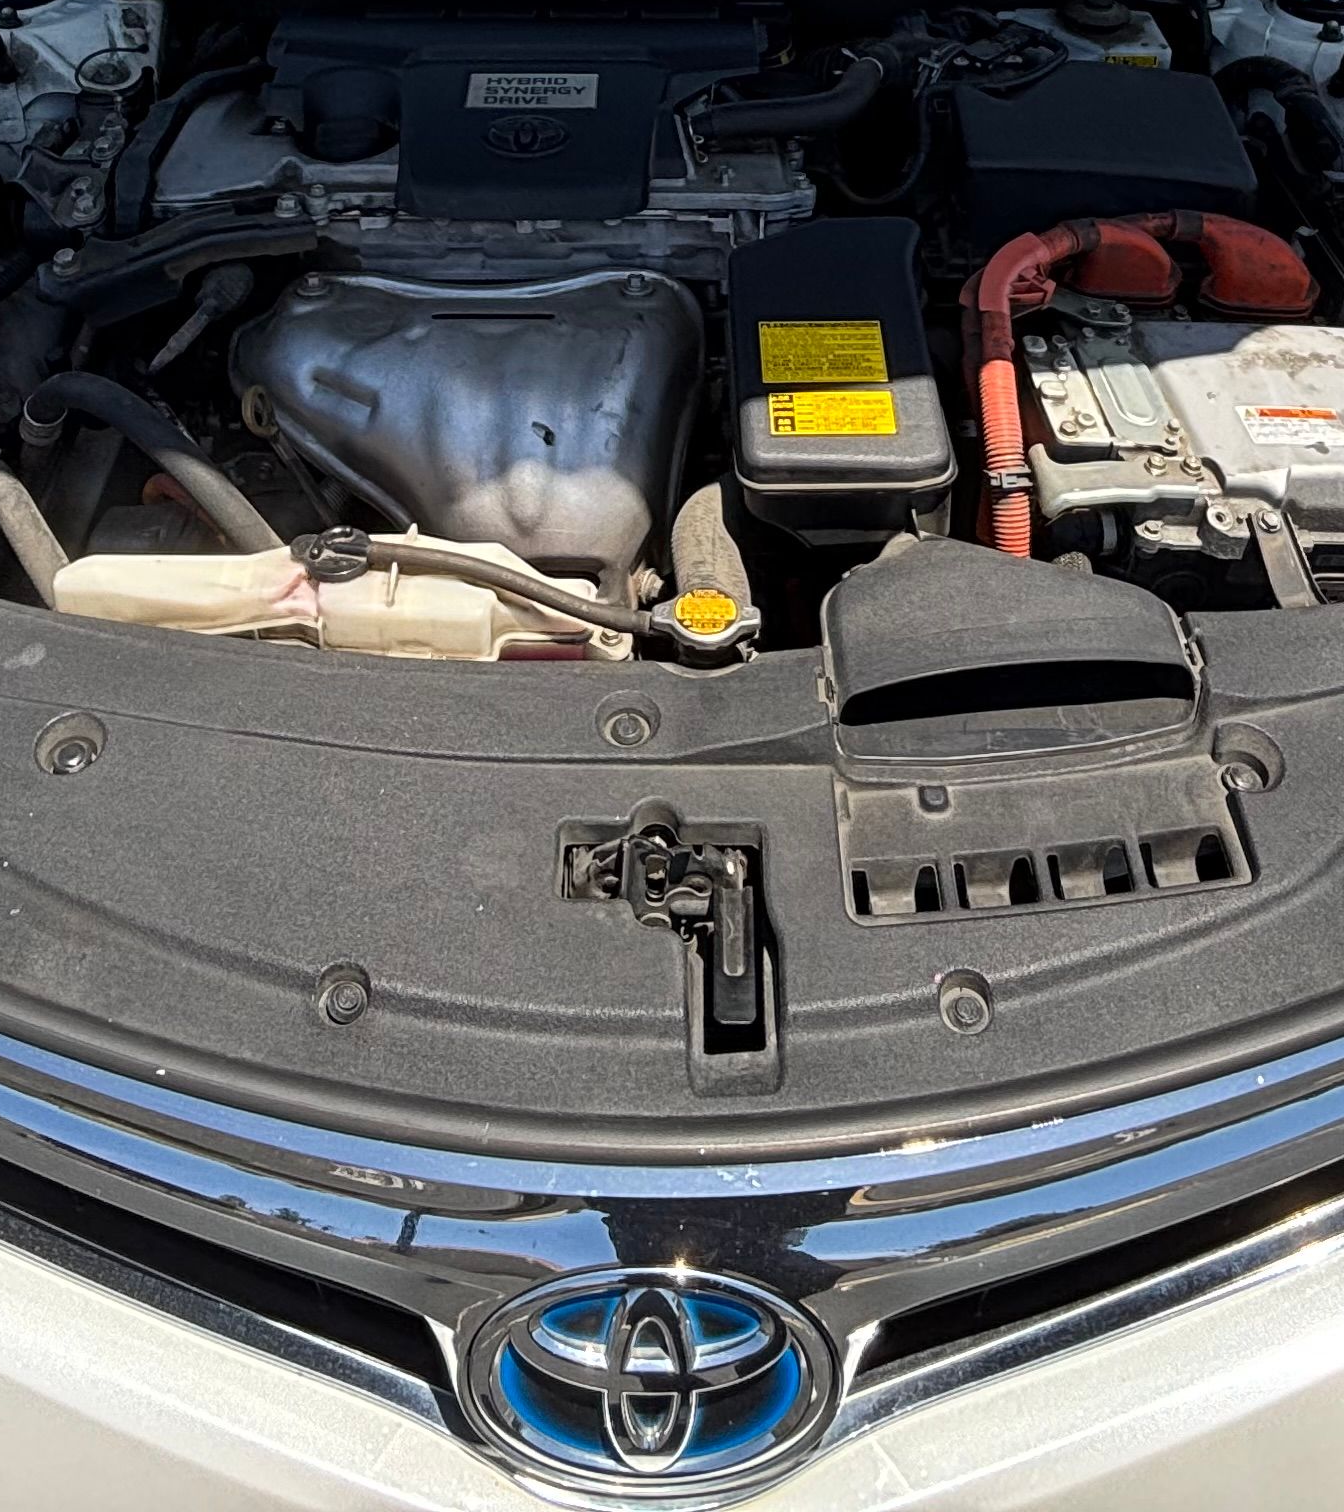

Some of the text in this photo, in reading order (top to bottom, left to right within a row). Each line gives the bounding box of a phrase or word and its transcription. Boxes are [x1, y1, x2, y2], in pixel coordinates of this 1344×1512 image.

[486, 77, 568, 86] HYBRID
[484, 86, 587, 95] SYNERGY
[483, 95, 549, 105] DRIVE
